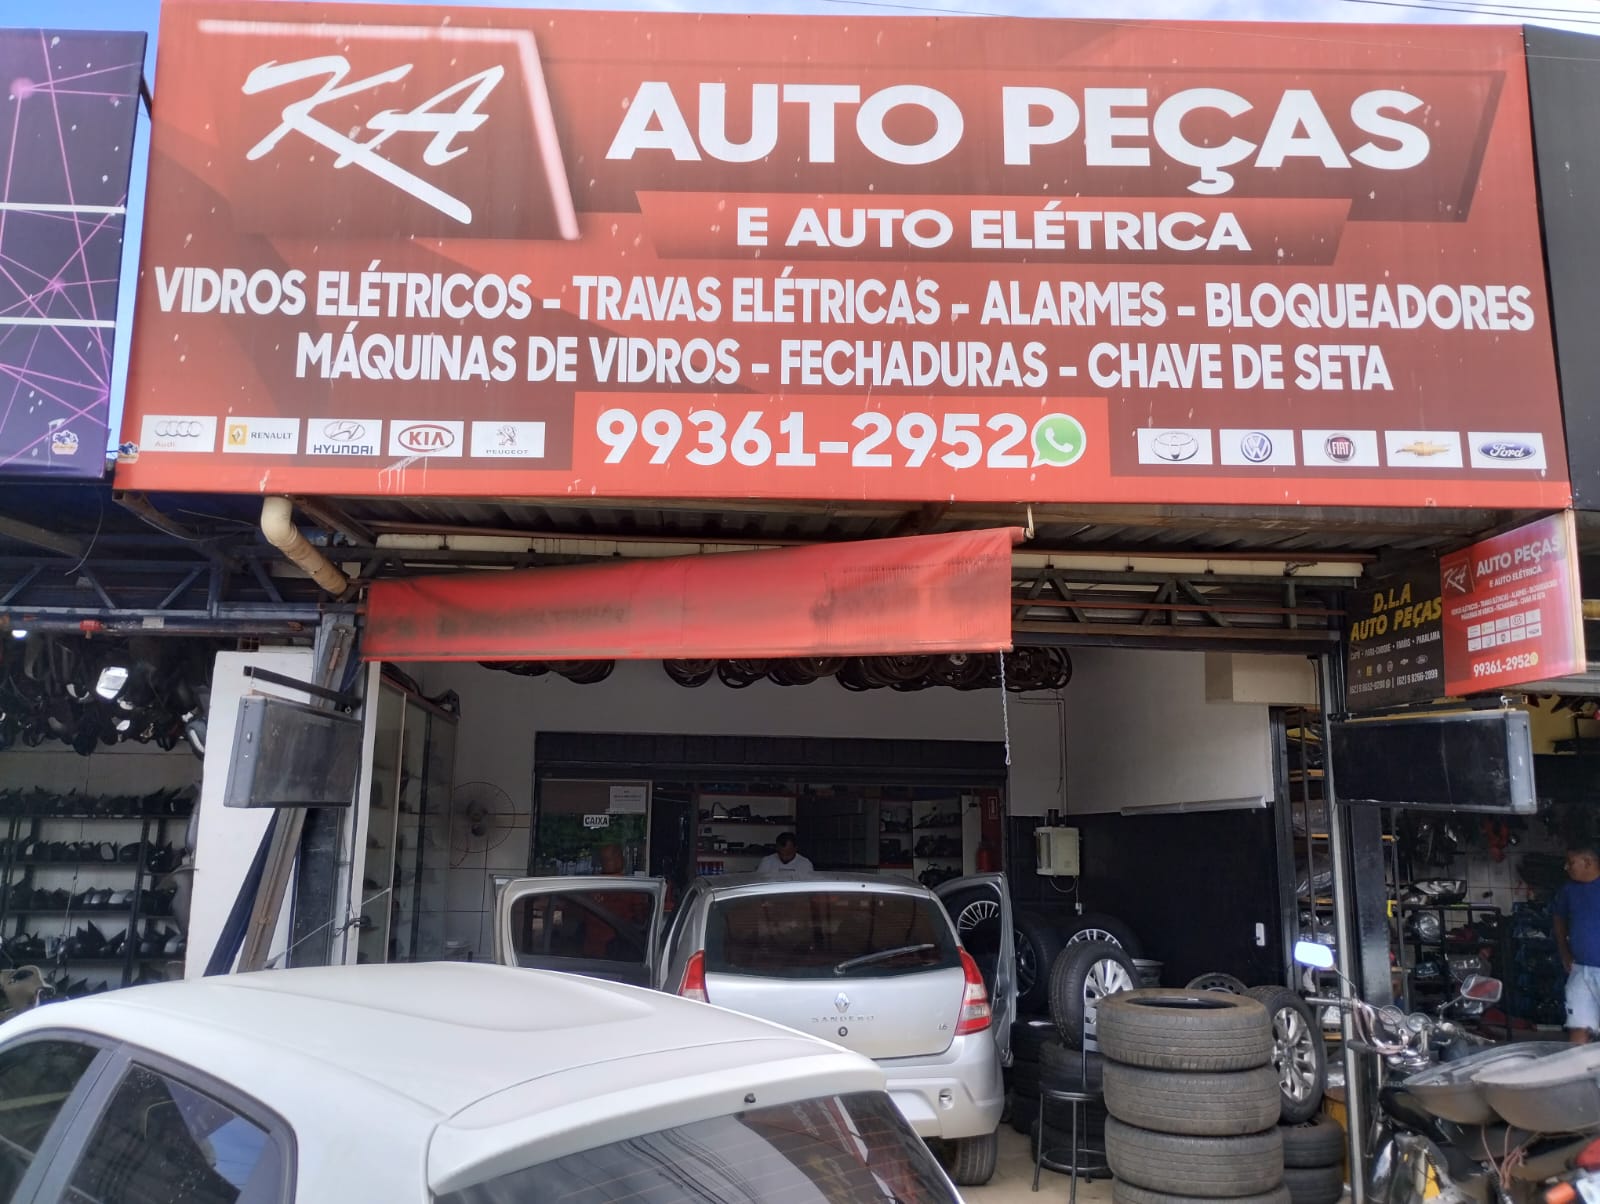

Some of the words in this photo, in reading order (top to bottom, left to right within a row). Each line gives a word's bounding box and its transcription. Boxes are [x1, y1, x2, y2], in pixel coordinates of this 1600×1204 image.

[242, 55, 505, 225] KA
[605, 81, 965, 166] AUTO
[1002, 86, 1431, 196] PEÇAS
[737, 207, 768, 247] E
[785, 207, 953, 249] AUTO
[970, 200, 1253, 252] ELÉTRICA
[154, 266, 307, 316] VIDROS
[316, 259, 533, 322] ELÉTRICOS
[572, 275, 722, 323] TRAVAS
[732, 266, 941, 326] ELÉTRICAS
[980, 280, 1167, 328] ALARMES
[1205, 282, 1536, 333] BLOQUEADORES
[295, 320, 517, 383] MÁQUINAS
[527, 336, 578, 382] DE
[588, 337, 741, 385] VIDROS
[780, 340, 1049, 389] FECHADURAS
[1087, 342, 1224, 390] CHAVE
[1232, 343, 1285, 390] DE
[1294, 344, 1394, 392] SETA
[251, 431, 293, 440] RENAULT
[313, 444, 374, 455] HYUNDAI
[409, 431, 445, 446] KIA
[596, 409, 1029, 470] 99361-2952
[1331, 441, 1350, 456] FIAT
[1489, 443, 1524, 457] Ford
[1476, 552, 1512, 577] AUTO
[1514, 536, 1561, 564] PEÇAS
[1494, 575, 1512, 587] AUTO
[1512, 565, 1542, 581] ELÉTRICA
[1351, 614, 1388, 640] AUTO
[1393, 596, 1442, 631] PEÇAS
[1473, 653, 1530, 677] 99361-2952
[585, 816, 608, 825] CAIXA
